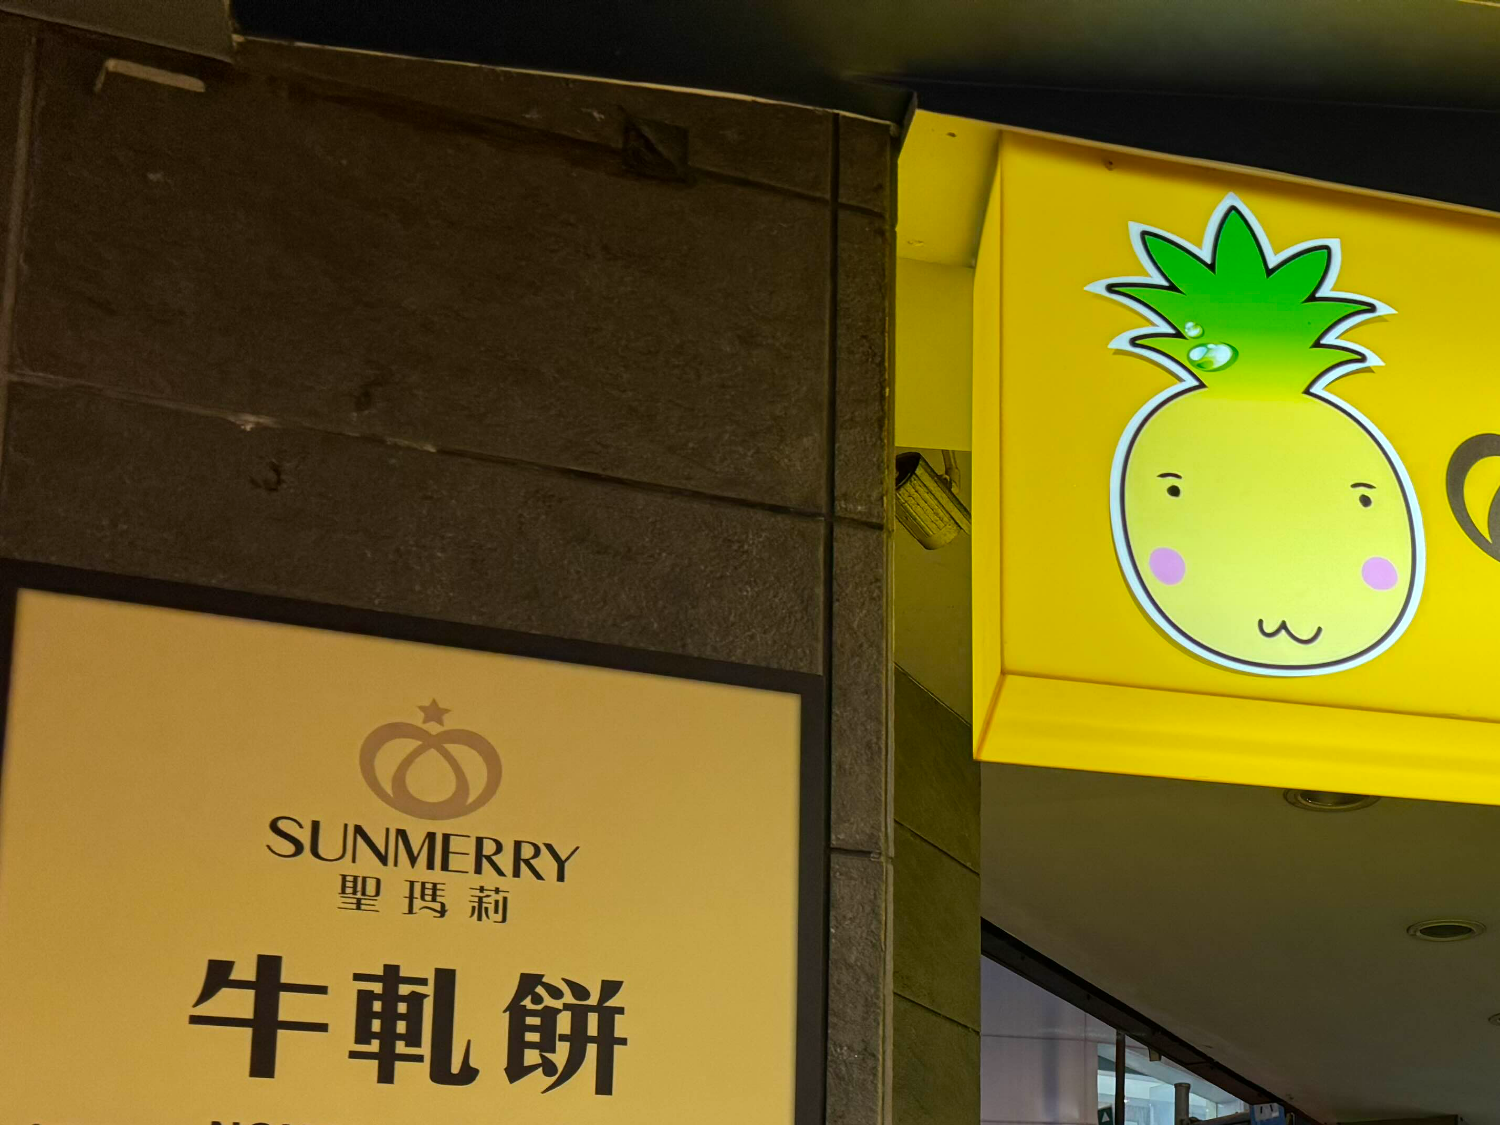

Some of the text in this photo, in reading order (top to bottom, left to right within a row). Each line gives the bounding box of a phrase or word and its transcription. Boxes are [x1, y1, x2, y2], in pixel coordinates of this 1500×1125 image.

[265, 815, 581, 883] SUNMERRY
[337, 873, 511, 925] 聖瑪莉
[188, 953, 629, 1097] 牛軋餅
